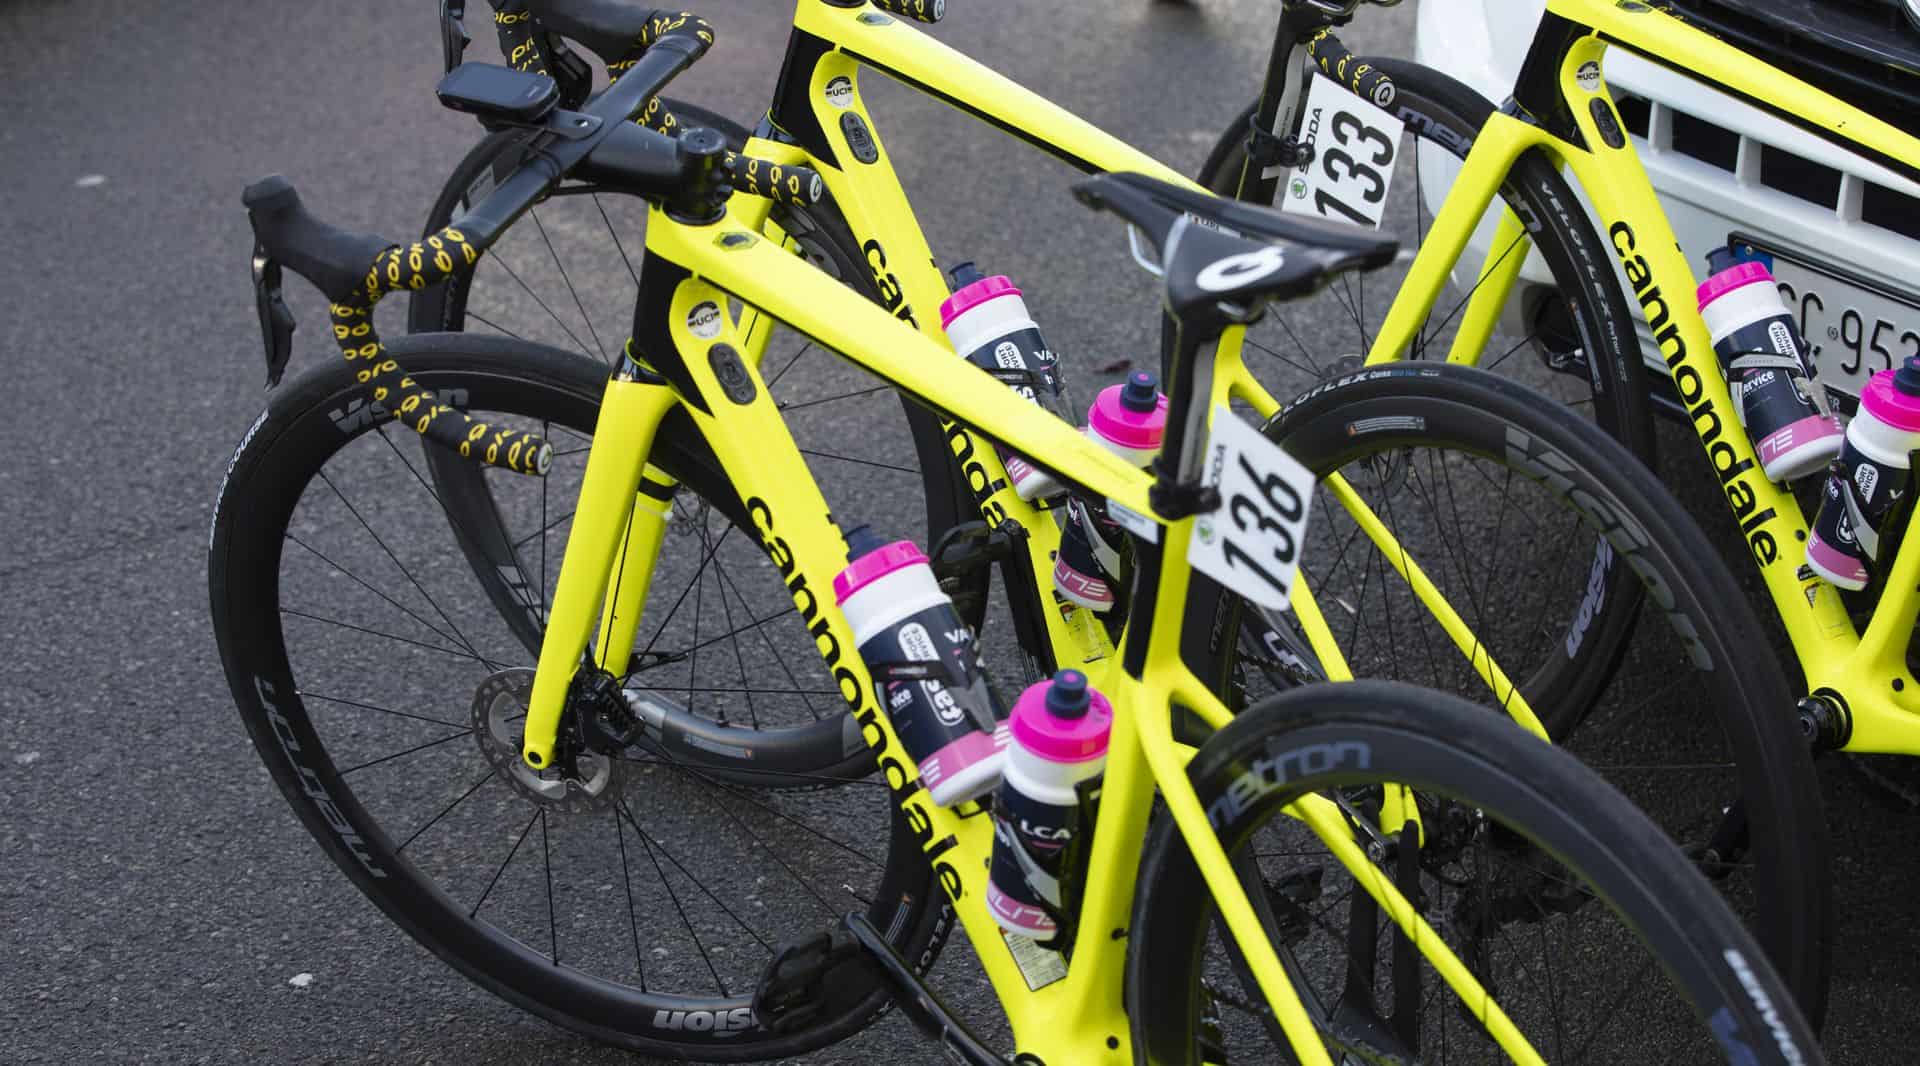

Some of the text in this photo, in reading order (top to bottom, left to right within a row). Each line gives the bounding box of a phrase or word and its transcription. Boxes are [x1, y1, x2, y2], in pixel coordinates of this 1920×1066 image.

[832, 87, 848, 96] UCI
[1299, 107, 1323, 175] SODA
[1314, 110, 1394, 226] 133
[1541, 180, 1613, 318] VELOFLEX
[695, 313, 715, 326] UCI
[1609, 221, 1777, 569] cannondale
[1743, 371, 1775, 393] ervice
[228, 408, 270, 475] COURSE
[1221, 451, 1304, 595] 136
[746, 496, 963, 901] cannondale
[1021, 820, 1072, 840] LCA
